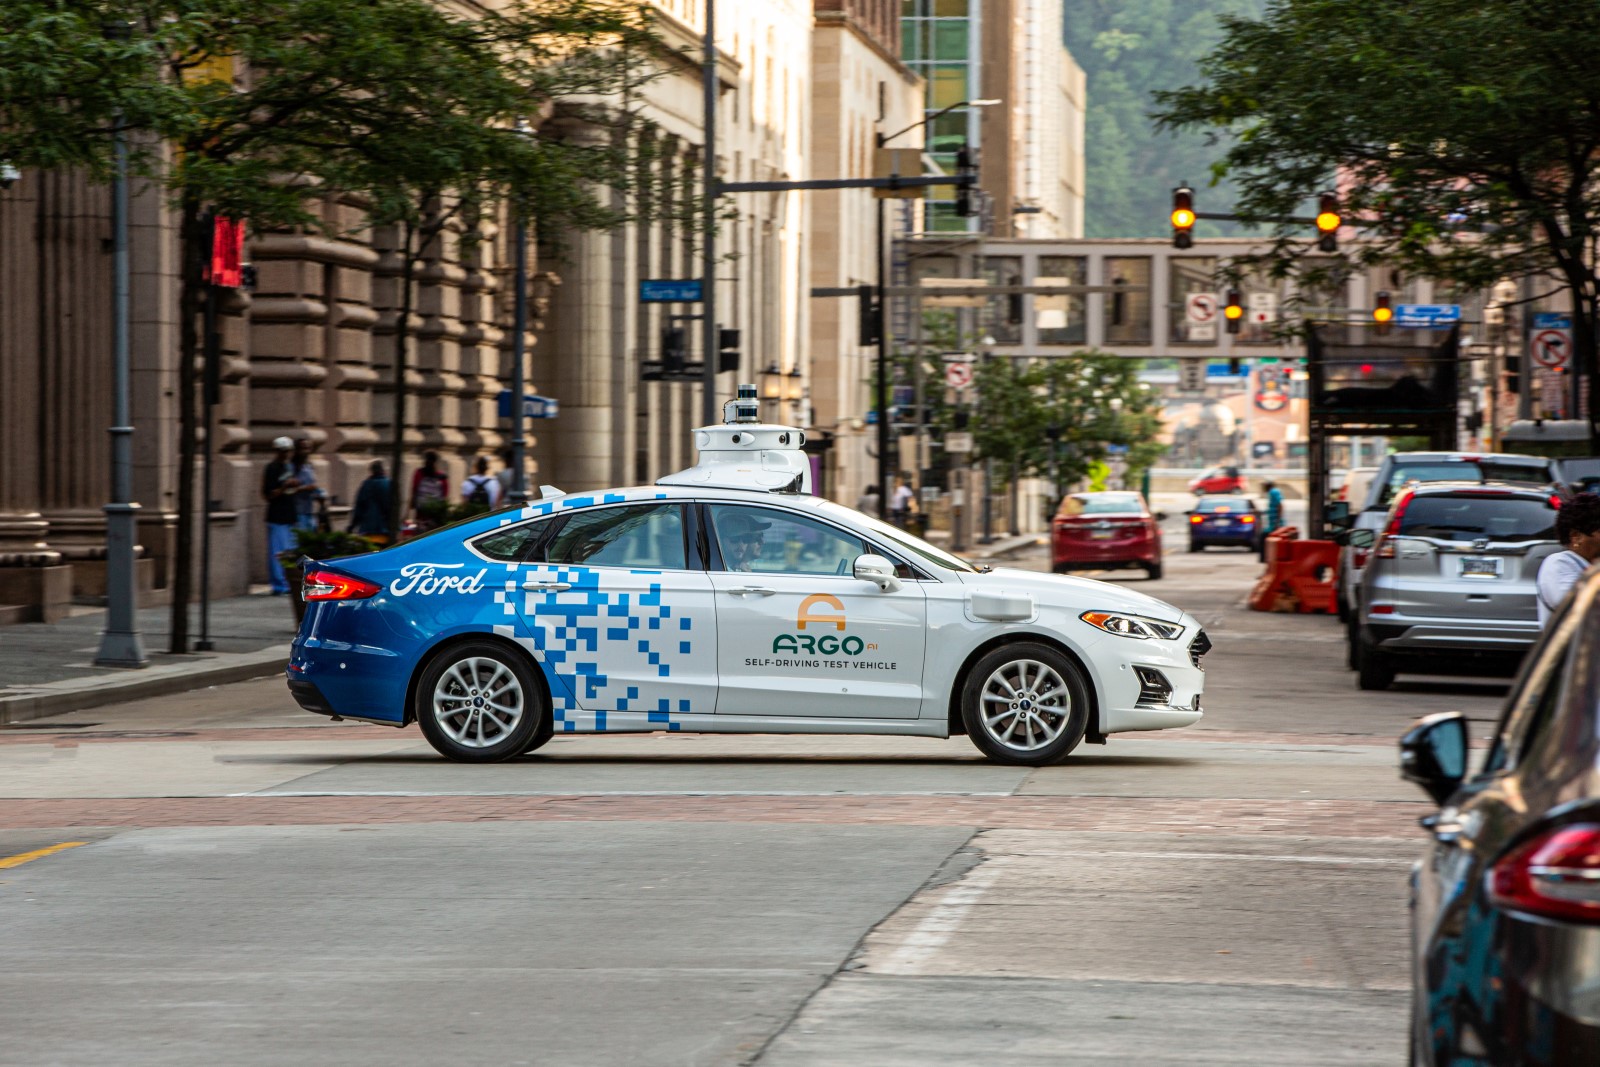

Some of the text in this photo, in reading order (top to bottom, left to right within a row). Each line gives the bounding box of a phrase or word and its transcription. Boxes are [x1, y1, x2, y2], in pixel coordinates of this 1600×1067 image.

[389, 562, 488, 597] Ford
[772, 634, 878, 656] ARGO AI
[745, 658, 897, 670] SELF-DRIVING TEST VEHICLE
